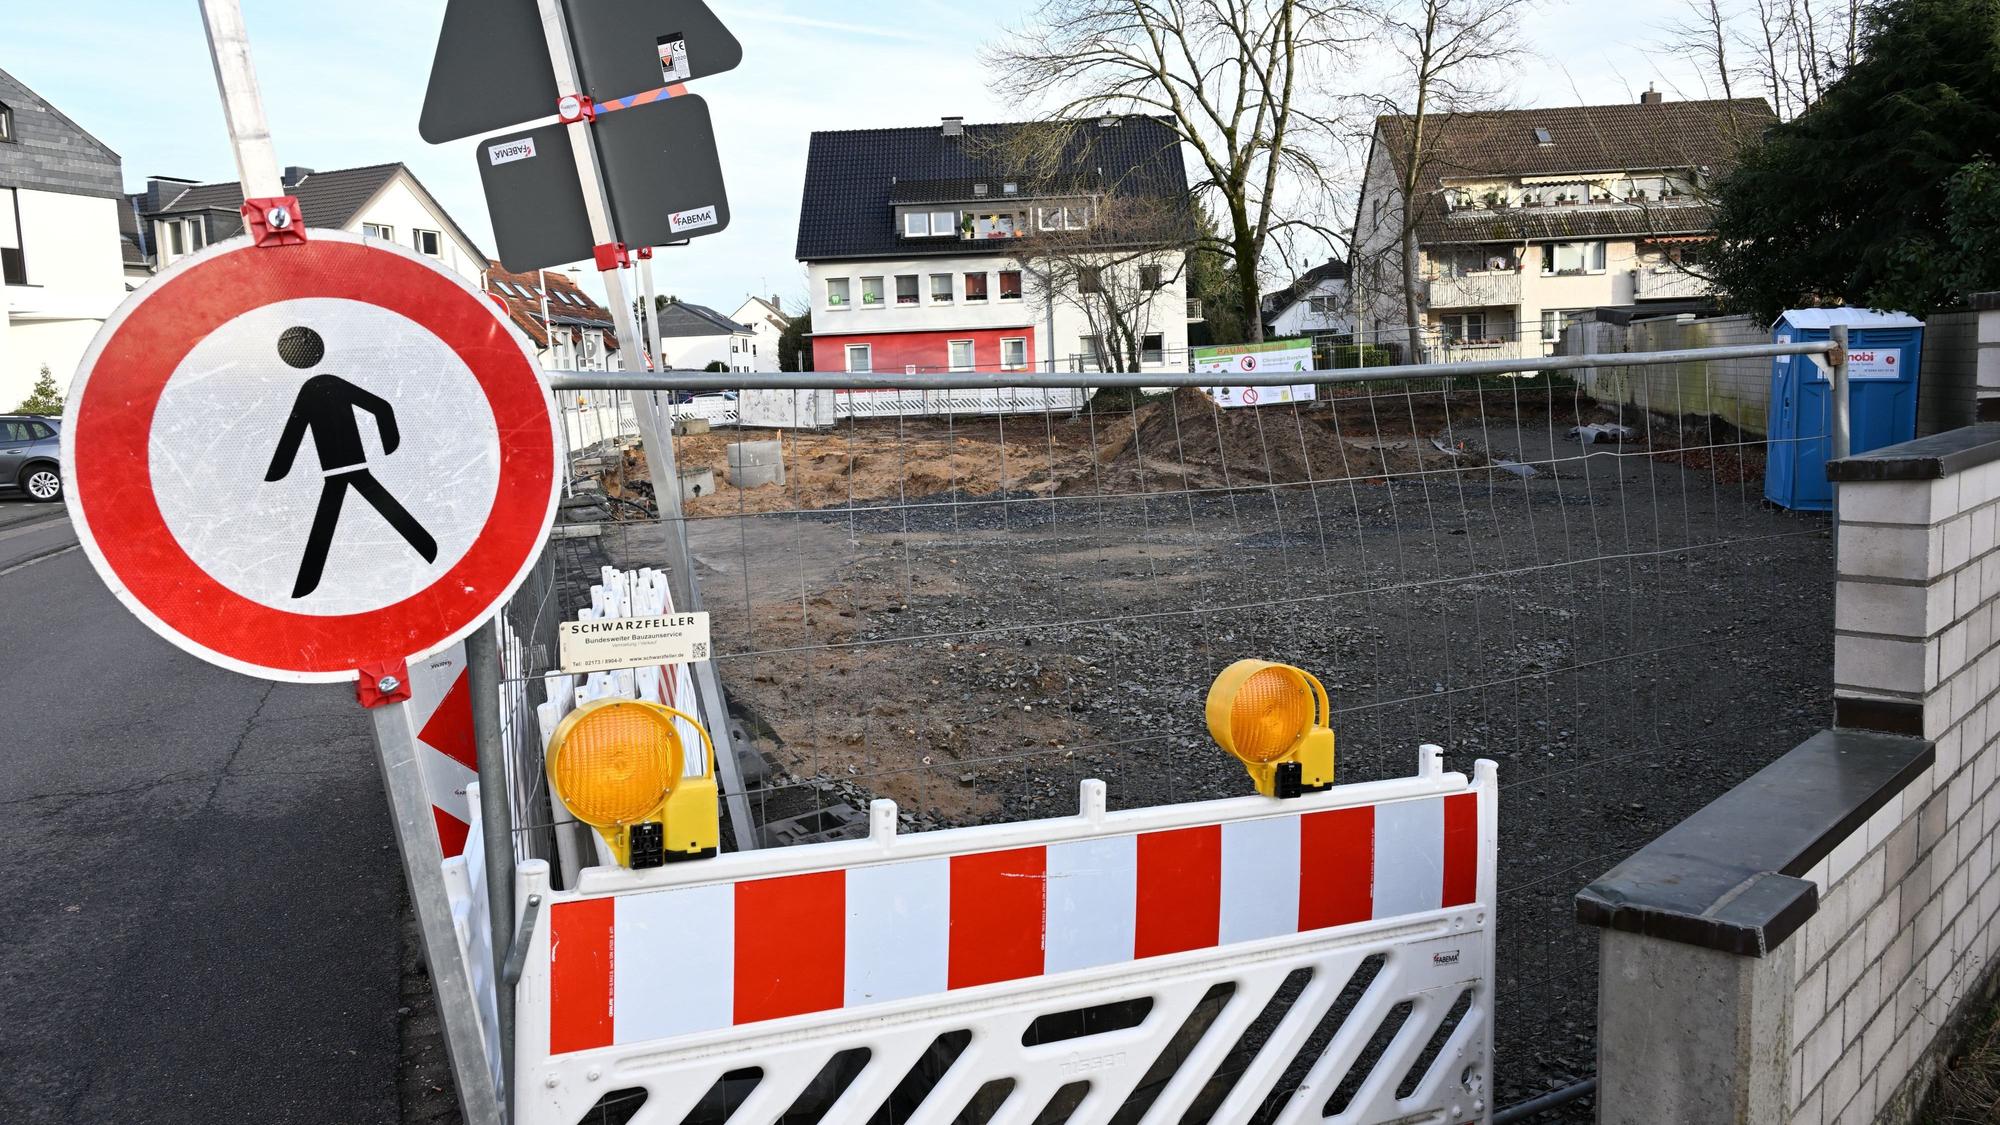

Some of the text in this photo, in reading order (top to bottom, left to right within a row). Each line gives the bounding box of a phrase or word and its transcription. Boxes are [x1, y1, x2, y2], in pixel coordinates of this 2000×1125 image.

[494, 144, 527, 158] FABEMA
[677, 211, 712, 226] FABEMA
[571, 616, 695, 634] SCHWARZFELLER
[585, 631, 683, 644] Bundesweiter Bauzaunservice
[629, 652, 684, 661] www.schwarzfeller.de
